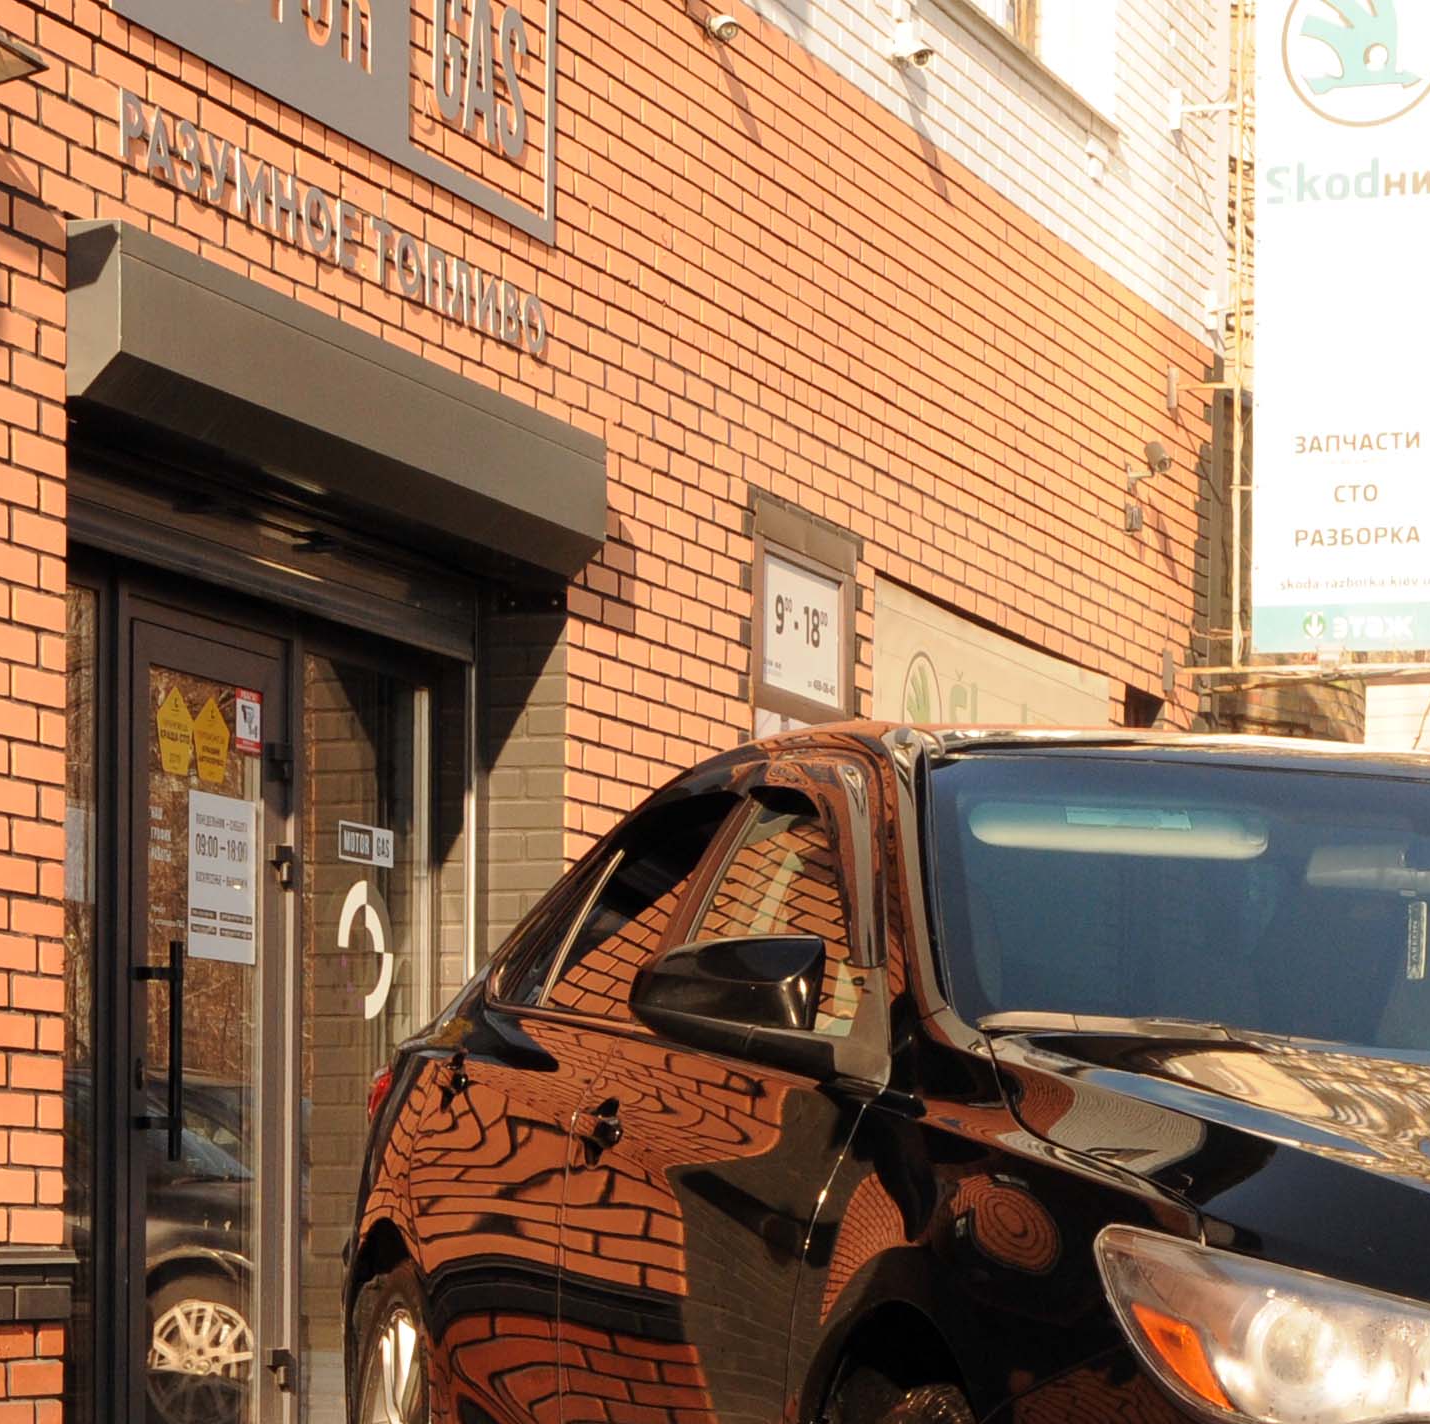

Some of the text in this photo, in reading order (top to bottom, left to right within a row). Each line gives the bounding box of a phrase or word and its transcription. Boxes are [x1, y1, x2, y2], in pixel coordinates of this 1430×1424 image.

[431, 0, 529, 160] GAS
[119, 86, 547, 353] РАЗУМНОЕ ТОПЛИВО
[1294, 431, 1420, 454] ЗАПЧАСТИ
[1333, 483, 1378, 503] СТО
[1294, 525, 1420, 548] РАЗБОРКА
[343, 829, 390, 859] MOTOR GAS
